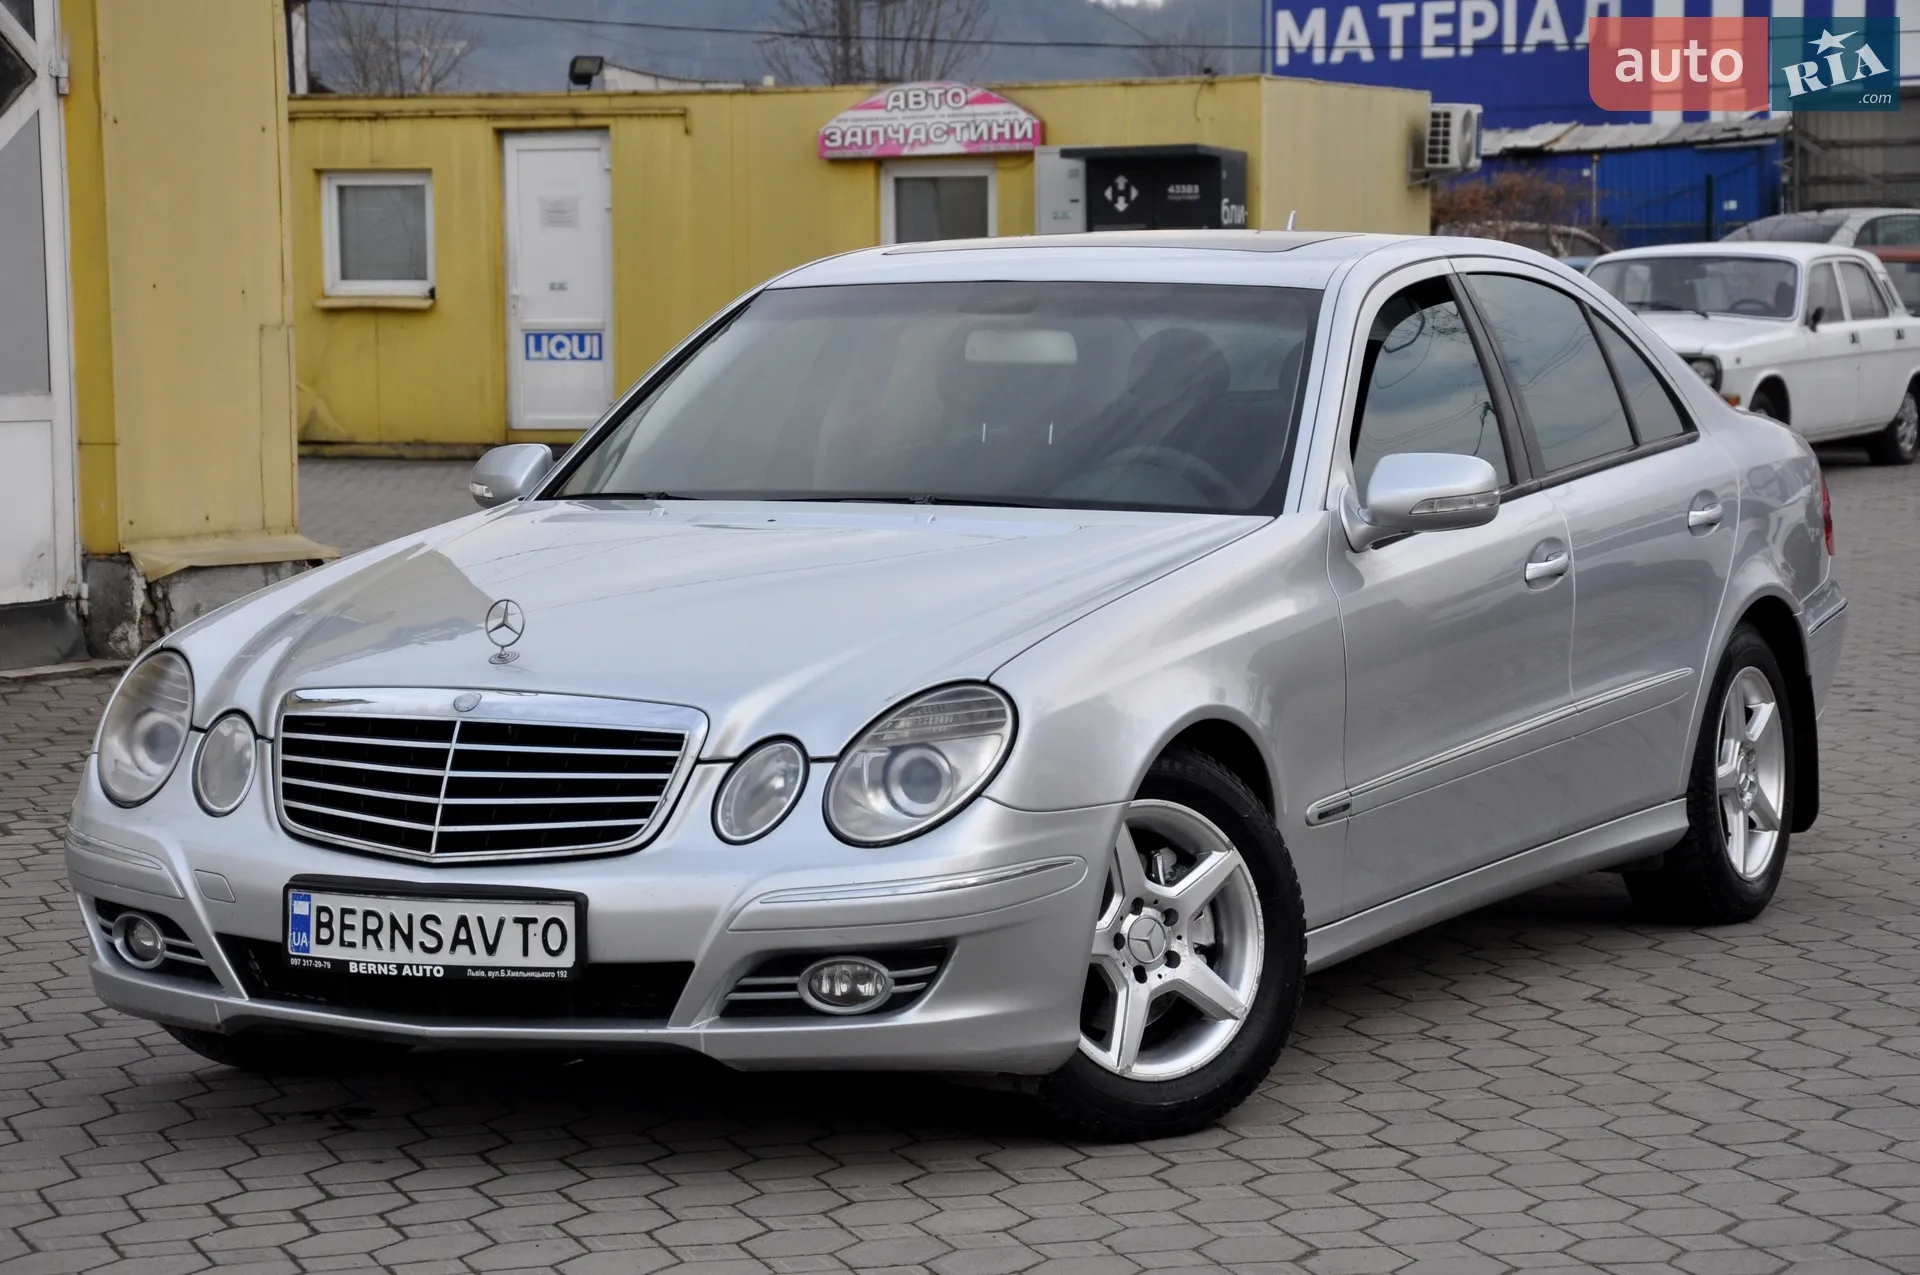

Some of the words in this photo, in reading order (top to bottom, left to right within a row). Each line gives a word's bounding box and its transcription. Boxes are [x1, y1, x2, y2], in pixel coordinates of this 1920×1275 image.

[885, 87, 968, 112] АВТО
[823, 118, 1034, 148] ЗАПЧАСТИНИ
[527, 334, 600, 360] LIQUI
[292, 932, 309, 947] UA
[315, 905, 568, 957] BERNSAVTO
[290, 958, 301, 966] 097
[302, 959, 331, 969] 317-29-79
[349, 962, 398, 975] BERNS
[402, 965, 444, 978] AUTO
[467, 969, 487, 978] Львів,
[557, 970, 568, 978] 192
